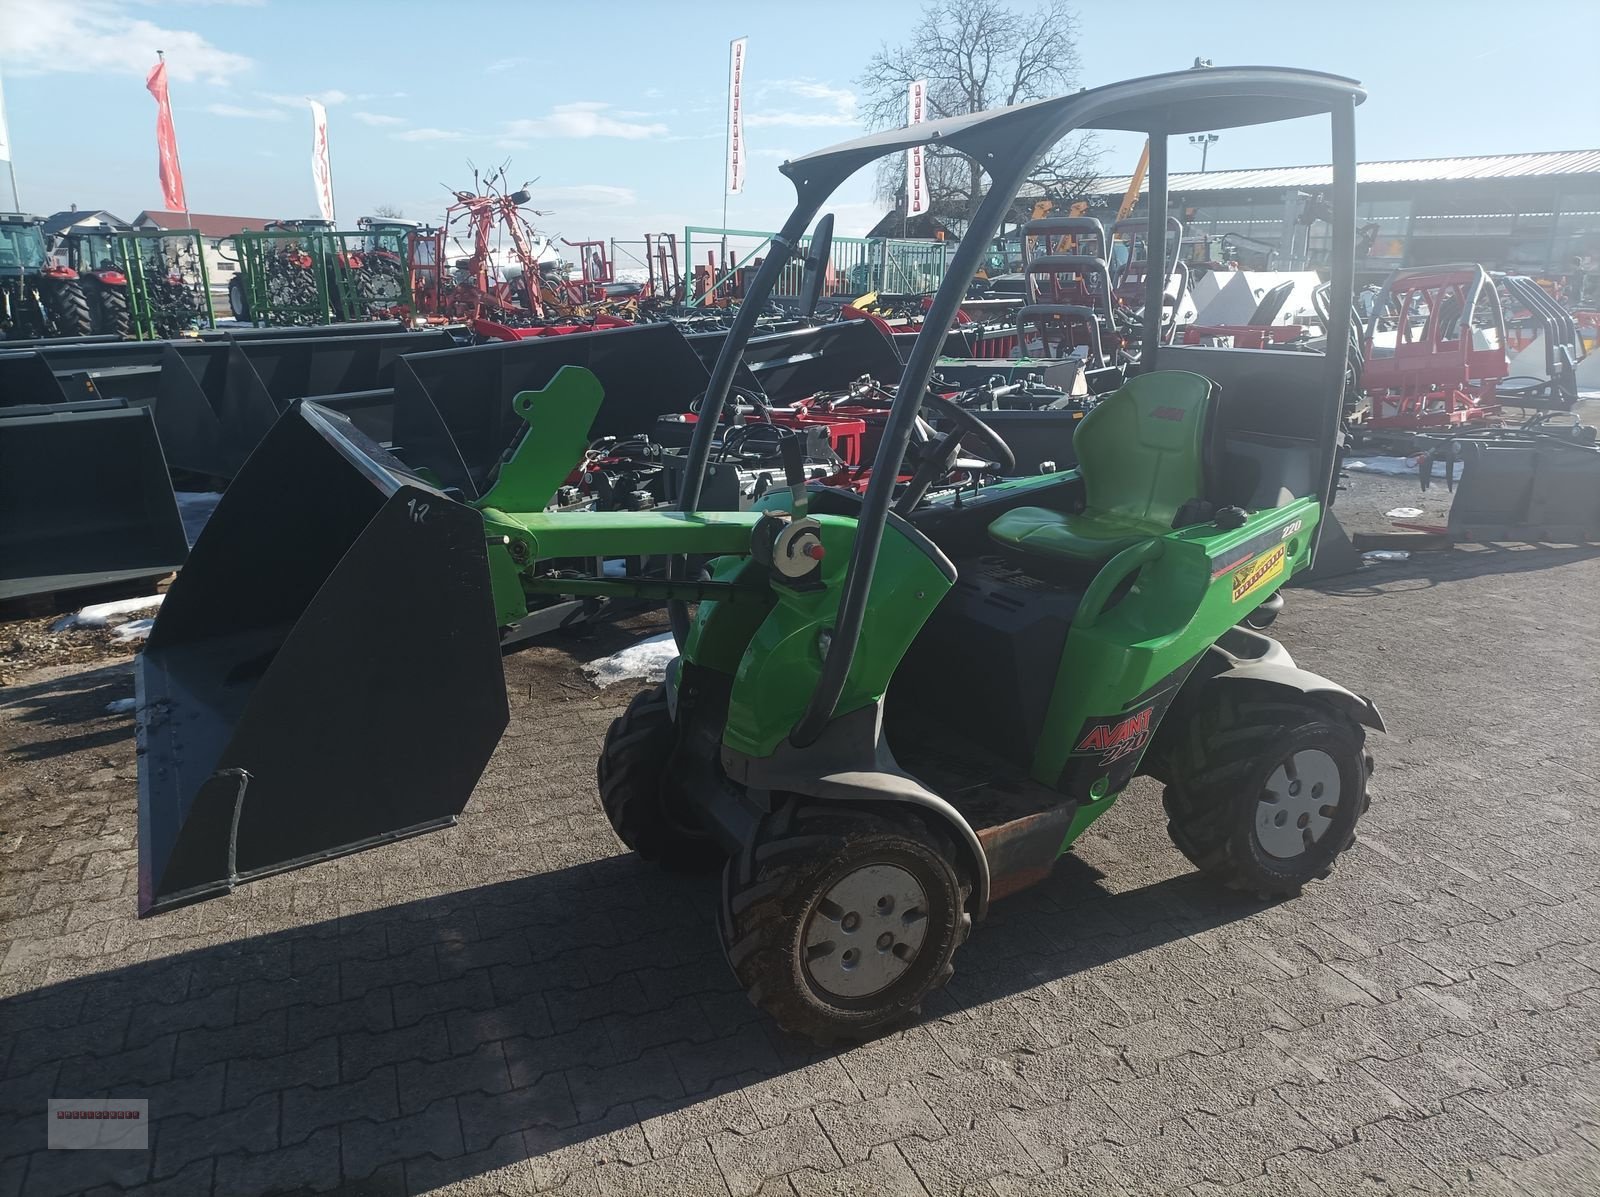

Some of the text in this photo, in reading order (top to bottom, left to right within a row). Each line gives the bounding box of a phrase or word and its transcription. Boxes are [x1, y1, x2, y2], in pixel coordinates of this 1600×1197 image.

[1281, 519, 1302, 539] 220
[1074, 706, 1154, 751] AVANT
[1098, 729, 1150, 767] 220
